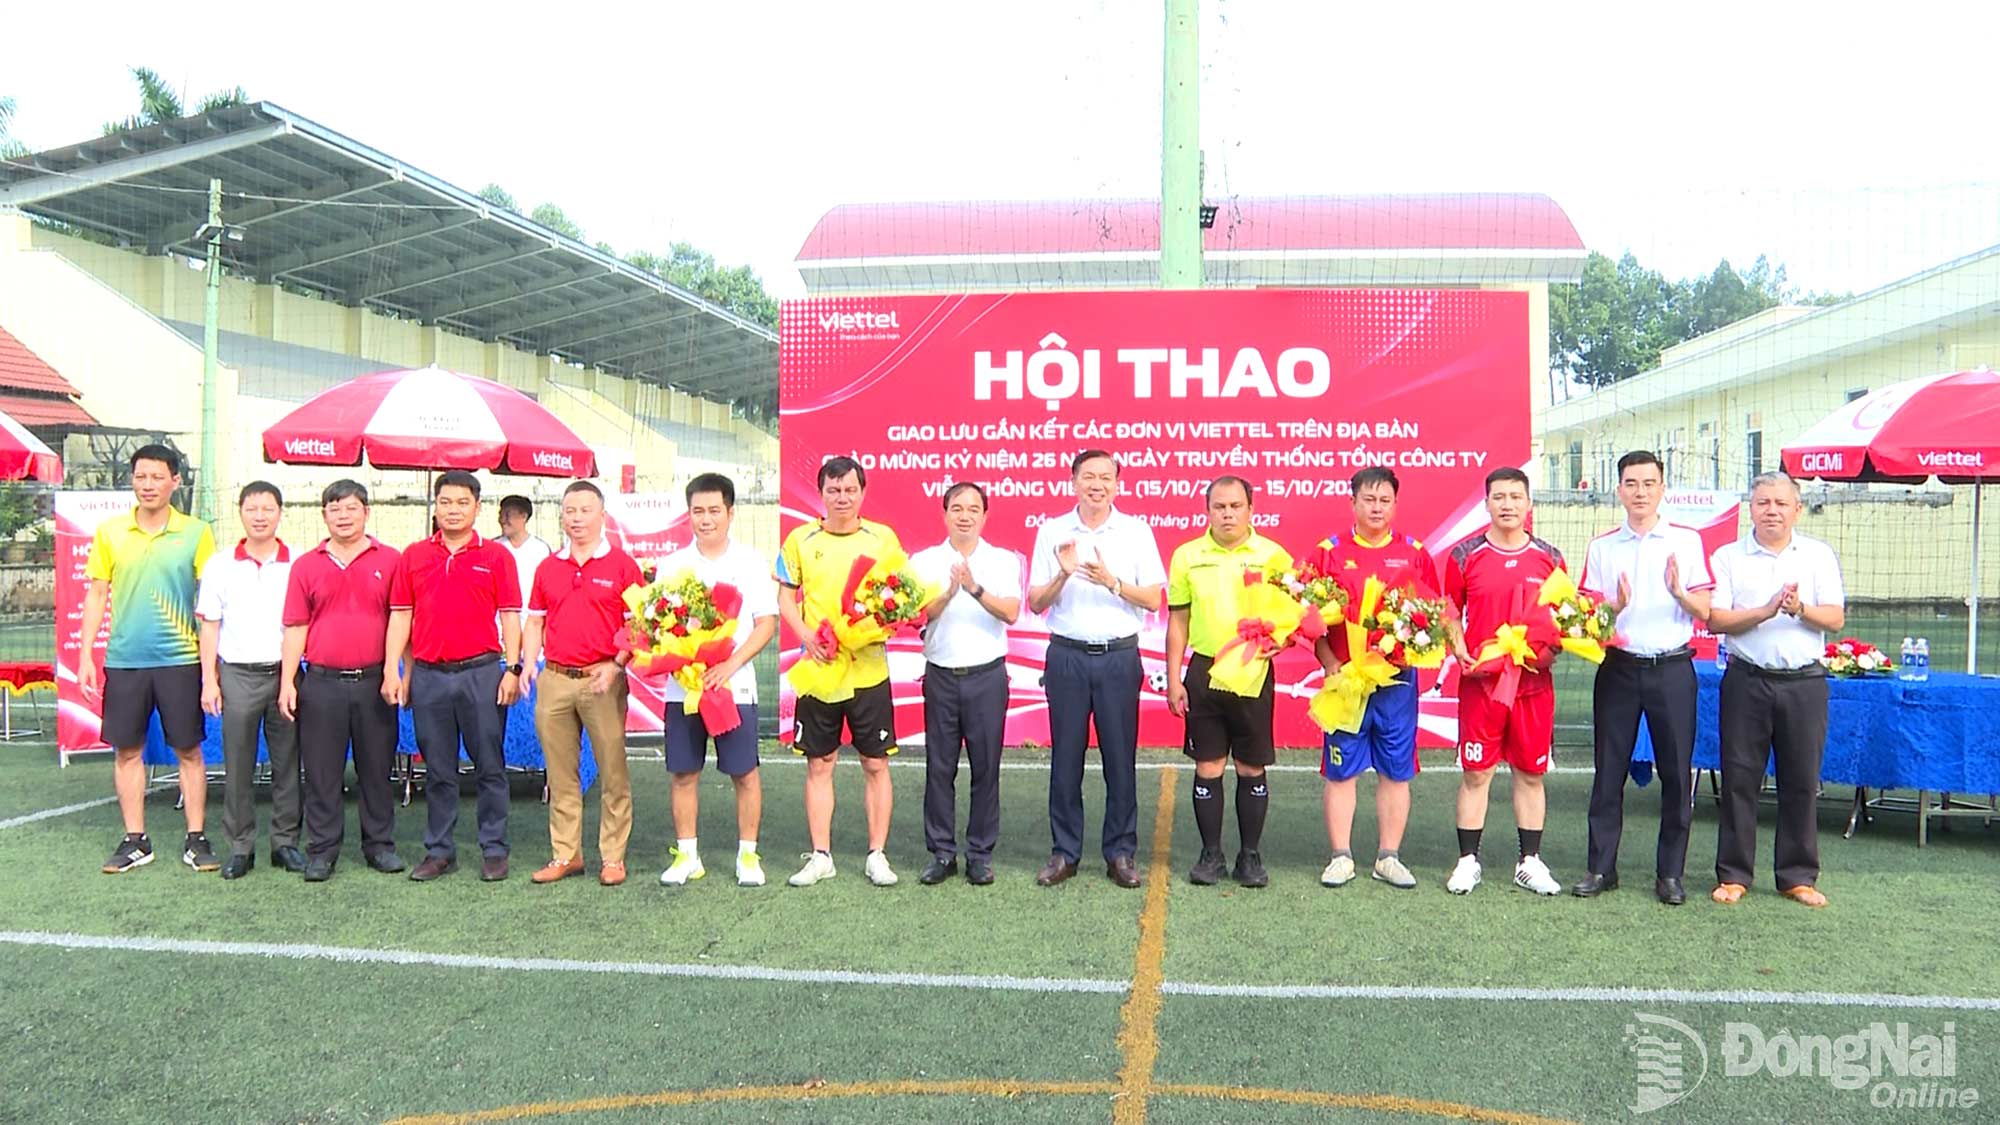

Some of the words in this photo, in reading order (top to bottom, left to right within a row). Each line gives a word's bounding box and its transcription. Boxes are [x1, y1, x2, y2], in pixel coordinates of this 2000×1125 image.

[974, 332, 1100, 411] HỘI
[1117, 347, 1331, 398] THAO
[887, 424, 935, 442] GIAO
[938, 423, 978, 441] LƯU
[982, 417, 1026, 441] GẮN
[1029, 417, 1068, 440] KẾT
[1072, 418, 1112, 439] CÁC
[1115, 422, 1161, 439] ĐƠN
[1165, 422, 1185, 441] VỊ
[1188, 422, 1273, 438] VIETTEL
[1276, 418, 1332, 438] TRÊN
[1336, 422, 1371, 441] ĐỊA
[1375, 418, 1418, 438] BÀN
[284, 439, 336, 457] viettel
[879, 449, 940, 469] MỪNG
[944, 449, 971, 469] KỶ
[976, 451, 1027, 471] NIỆM
[1032, 452, 1056, 468] 26
[1112, 446, 1170, 467] NGÀY
[1173, 443, 1258, 467] TRUYỀN
[1262, 444, 1334, 467] THỐNG
[1337, 444, 1396, 467] TỔNG
[1400, 447, 1455, 467] CÔNG
[1458, 451, 1487, 467] TY
[532, 453, 573, 471] viettel
[1917, 450, 1984, 467] viettel
[1664, 494, 1715, 505] viettel
[1150, 513, 1189, 530] tháng
[1192, 514, 1208, 527] 10
[1251, 514, 1280, 527] 026
[1330, 745, 1342, 766] 15
[1465, 742, 1483, 762] 68
